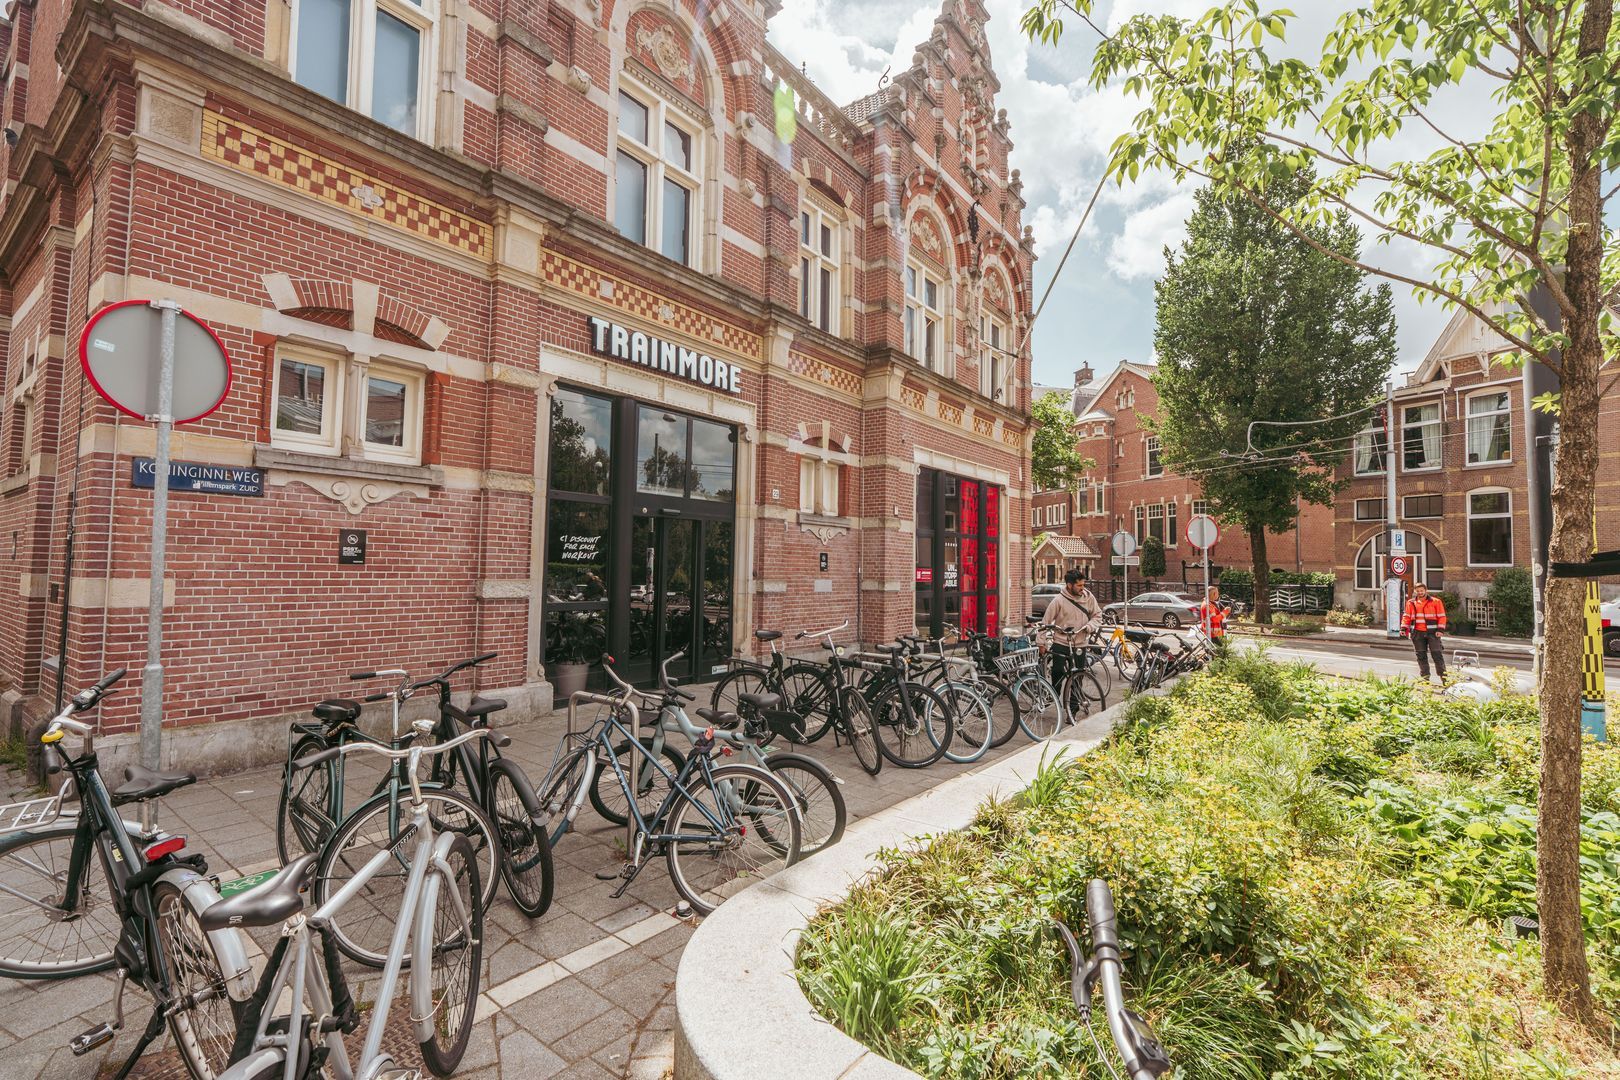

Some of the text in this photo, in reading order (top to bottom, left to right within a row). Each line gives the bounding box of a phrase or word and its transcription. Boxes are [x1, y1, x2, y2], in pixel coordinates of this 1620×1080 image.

[591, 316, 741, 394] TRAINMORE
[139, 462, 260, 484] KOINGINNEWEG
[561, 551, 599, 561] WORKOUT
